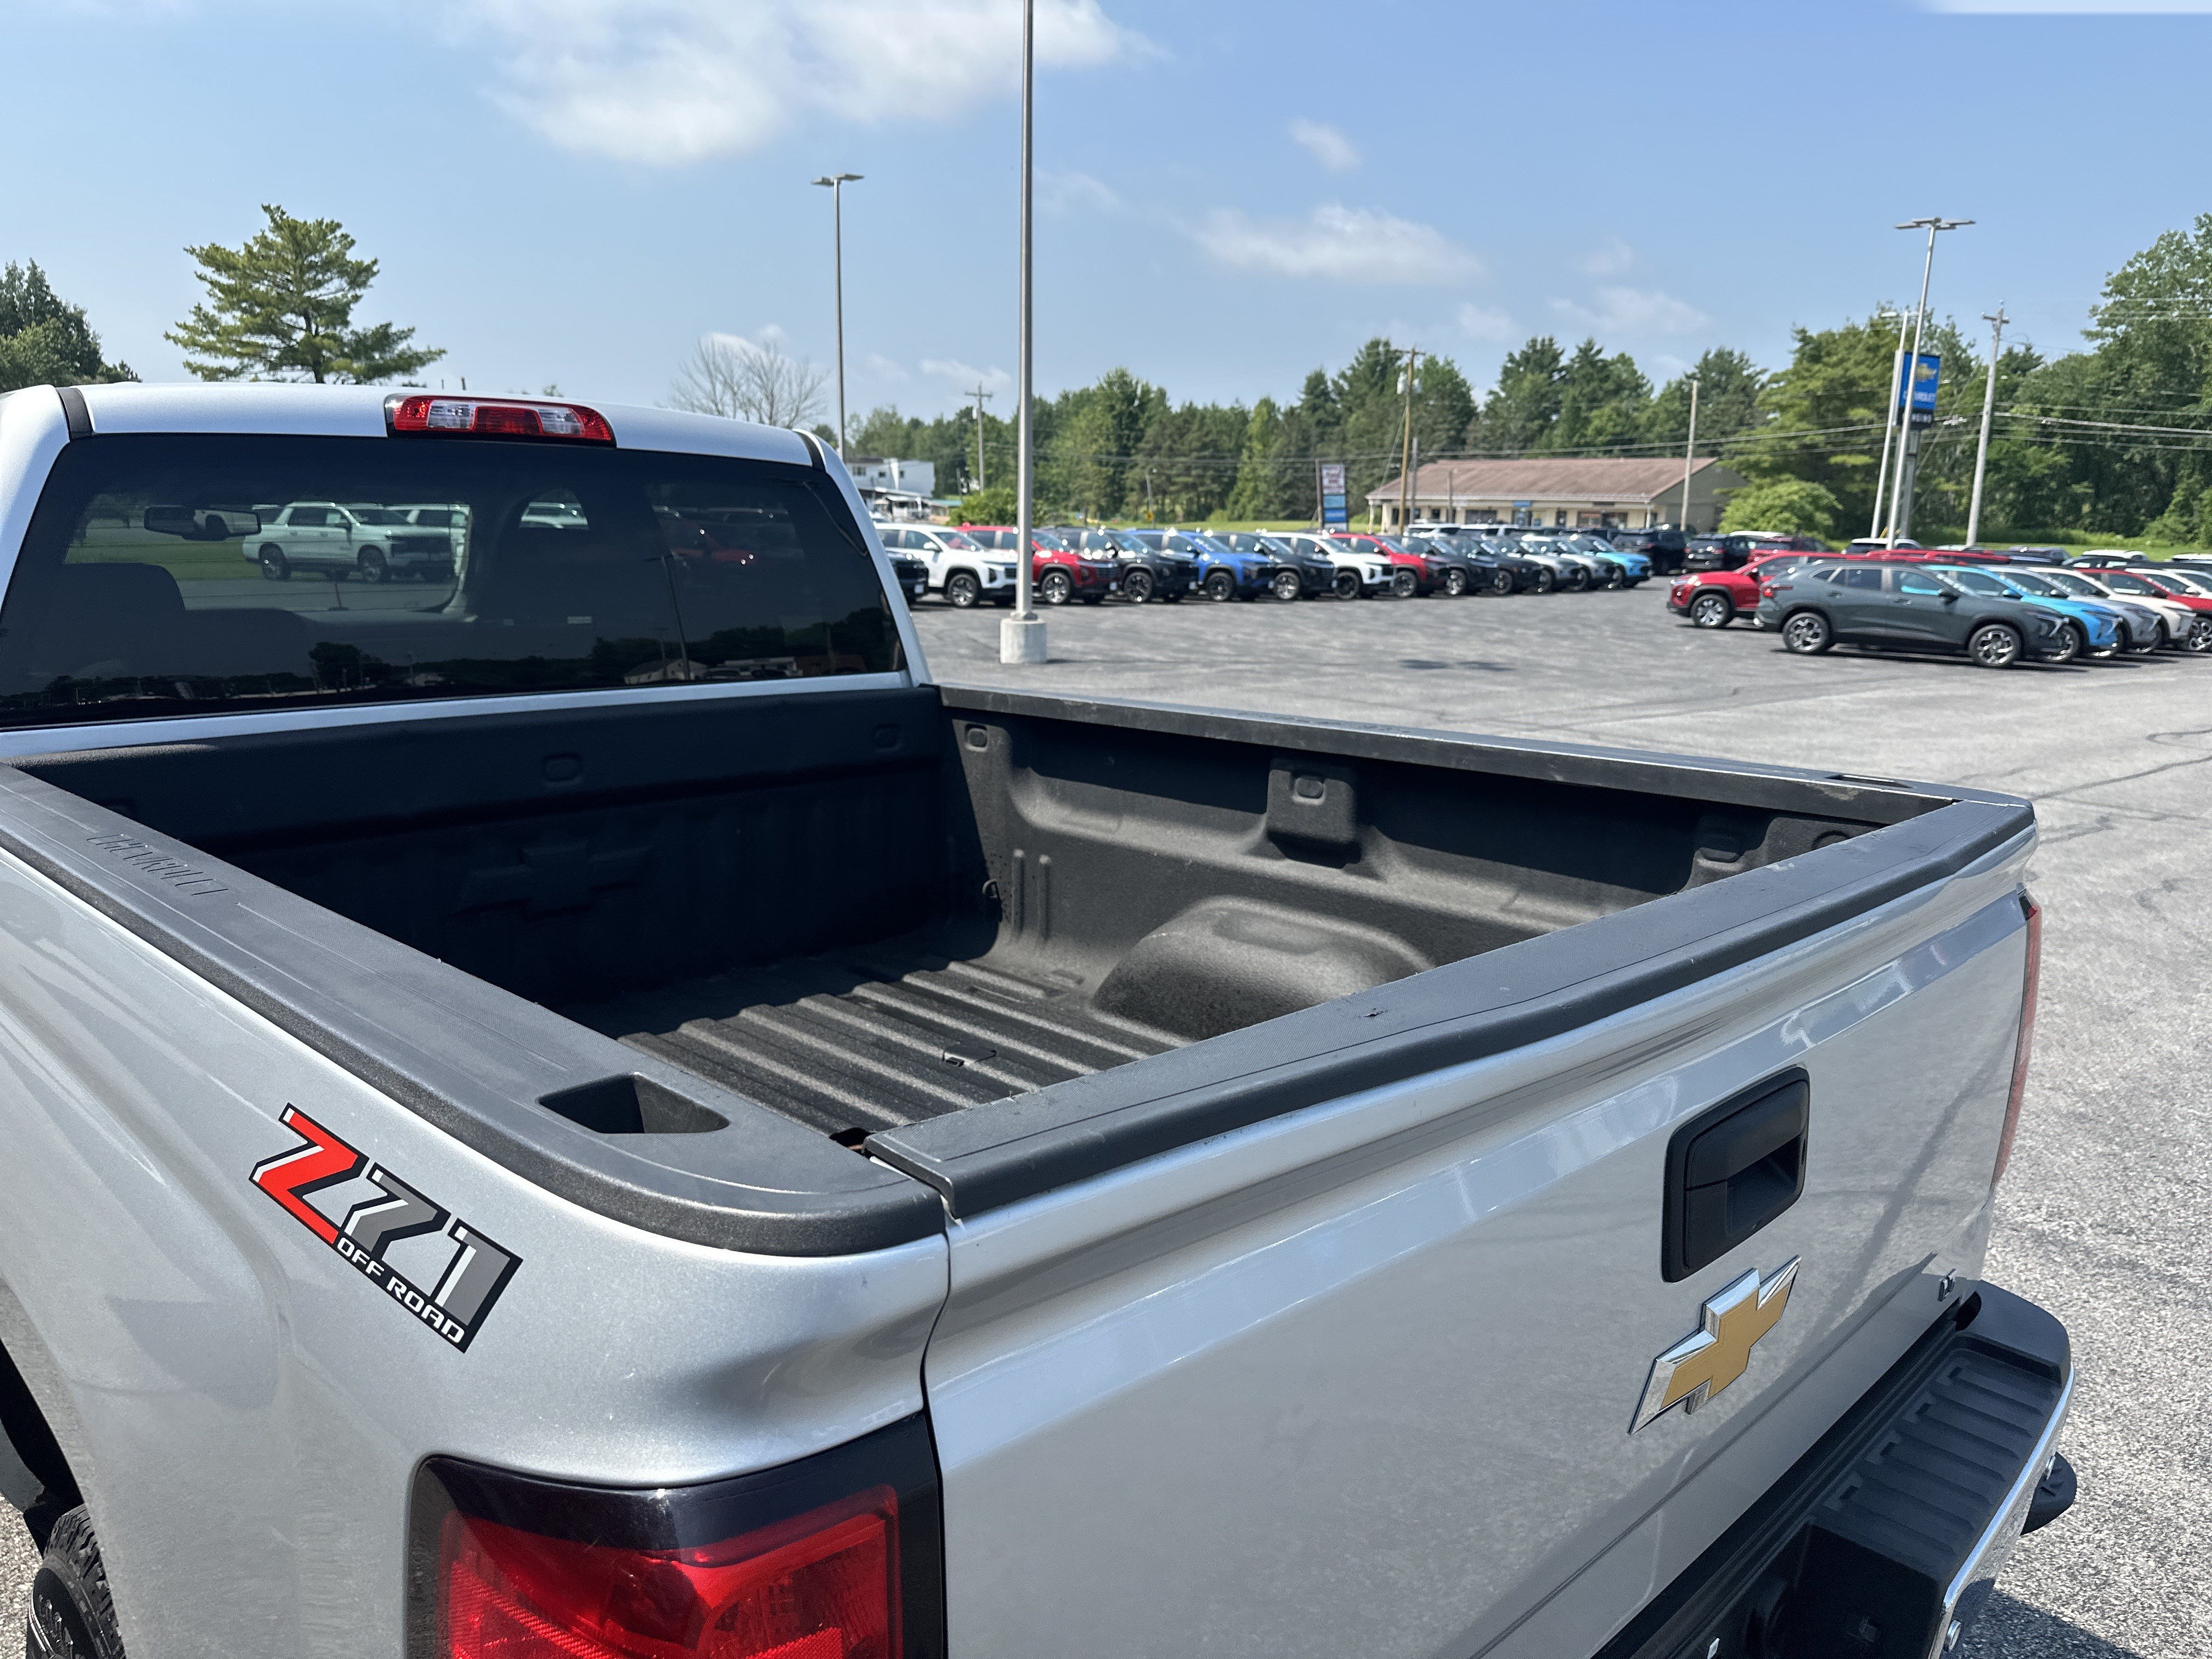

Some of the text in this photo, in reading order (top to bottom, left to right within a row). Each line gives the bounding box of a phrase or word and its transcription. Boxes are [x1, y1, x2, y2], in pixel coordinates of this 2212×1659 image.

[249, 1102, 523, 1328] Z71
[336, 1237, 465, 1344] OFF ROAD
